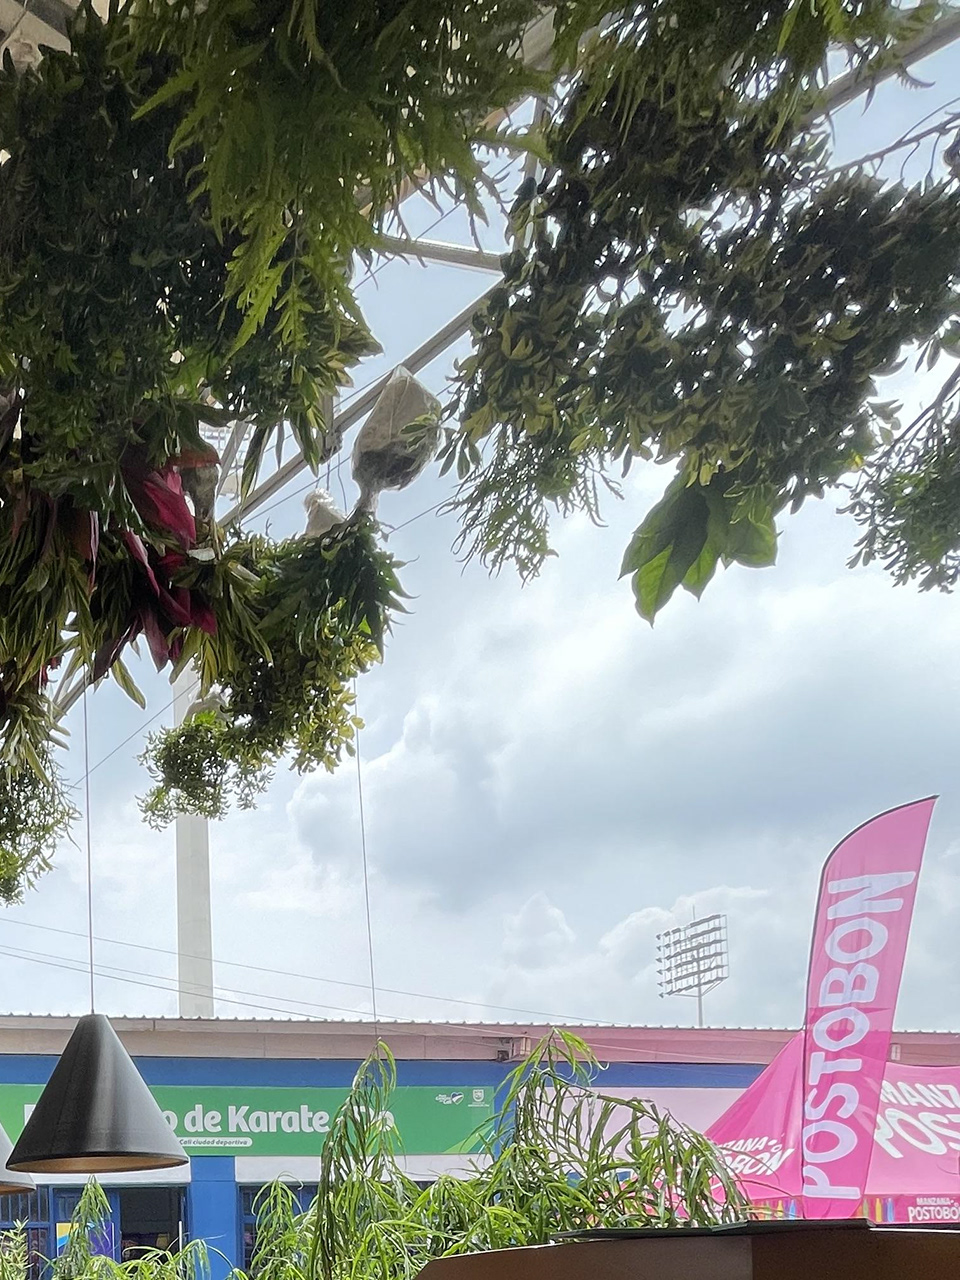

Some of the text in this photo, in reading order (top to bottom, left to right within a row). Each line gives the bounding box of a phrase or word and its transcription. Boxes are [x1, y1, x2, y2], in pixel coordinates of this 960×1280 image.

[803, 871, 917, 1199] POSTOBON
[184, 1104, 222, 1133] de
[228, 1104, 330, 1133] Karate
[179, 1138, 248, 1147] Cali ciudad deportiva
[907, 1206, 960, 1223] POSTOBO
